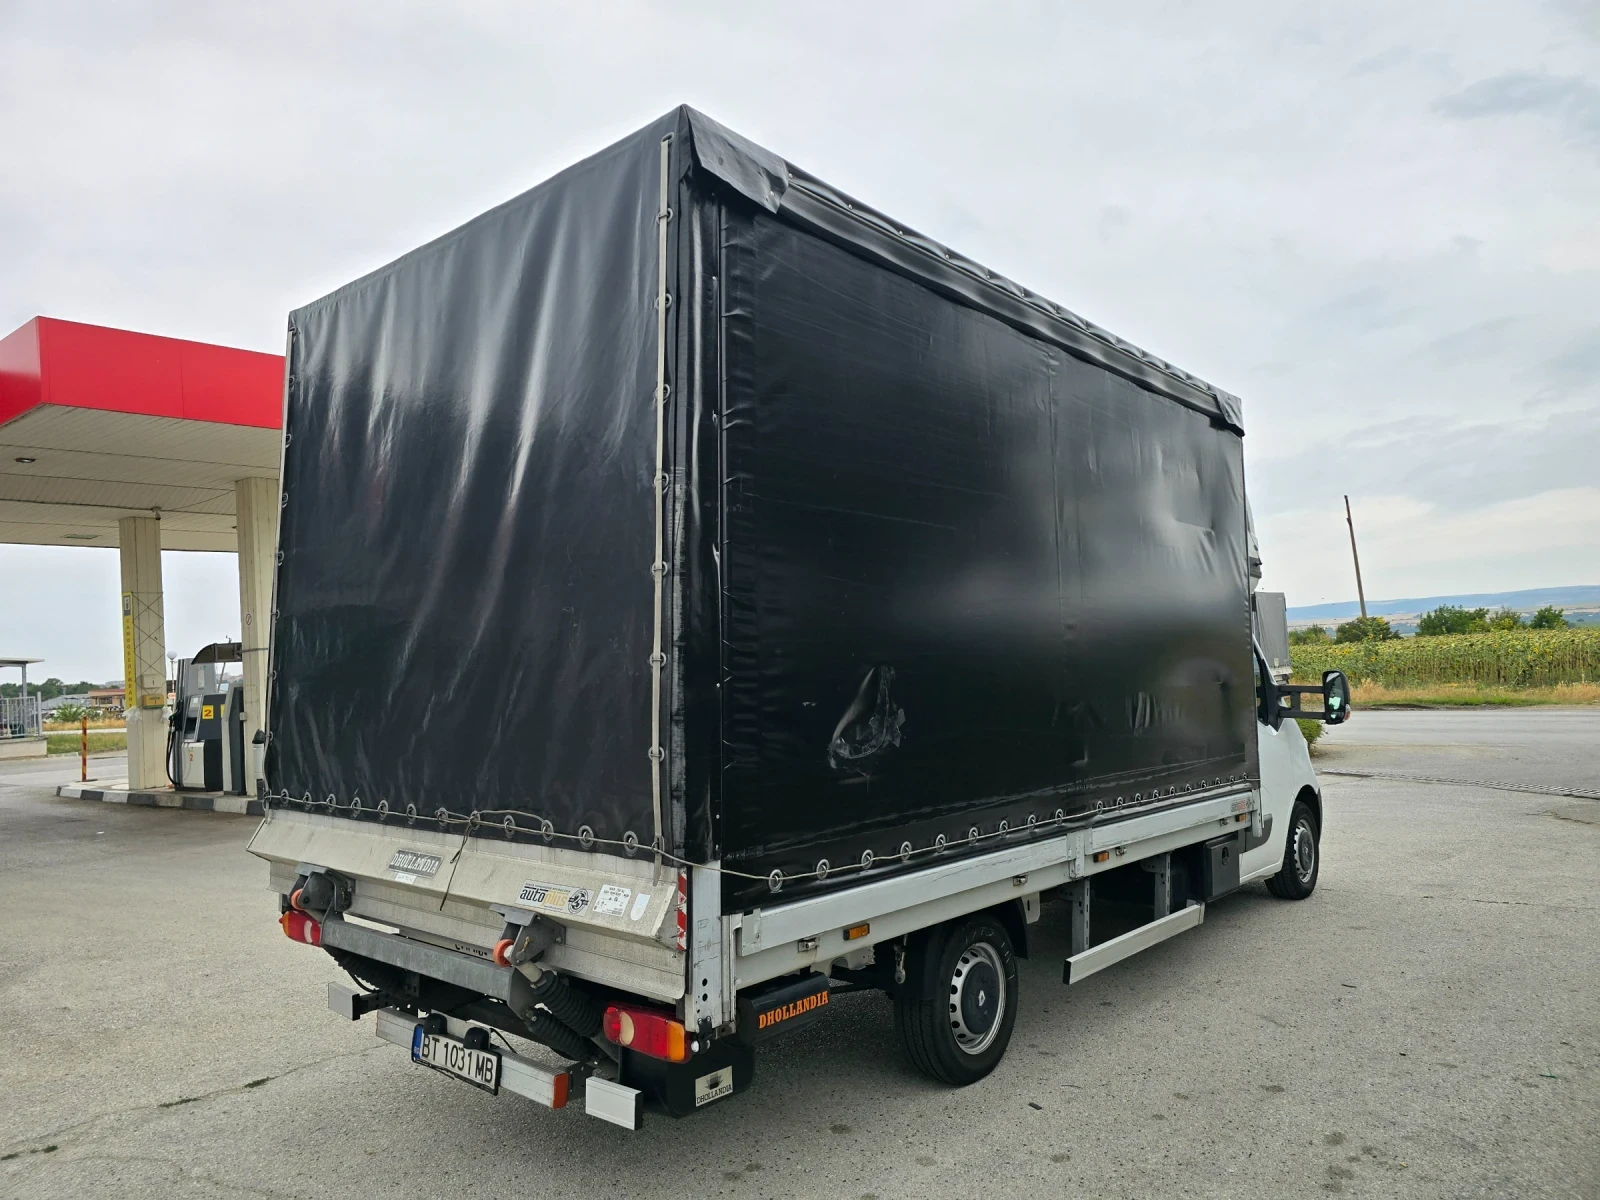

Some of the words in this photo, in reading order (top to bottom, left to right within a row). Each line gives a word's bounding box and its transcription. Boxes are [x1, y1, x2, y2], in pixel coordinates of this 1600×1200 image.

[204, 709, 212, 717] 2
[391, 852, 440, 874] DHOLLANDIA
[758, 990, 829, 1029] DHOLLANDIA
[421, 1034, 440, 1061] BT
[443, 1041, 473, 1075] 1031
[475, 1053, 494, 1083] MB
[696, 1084, 733, 1104] DHOLLANDIA
